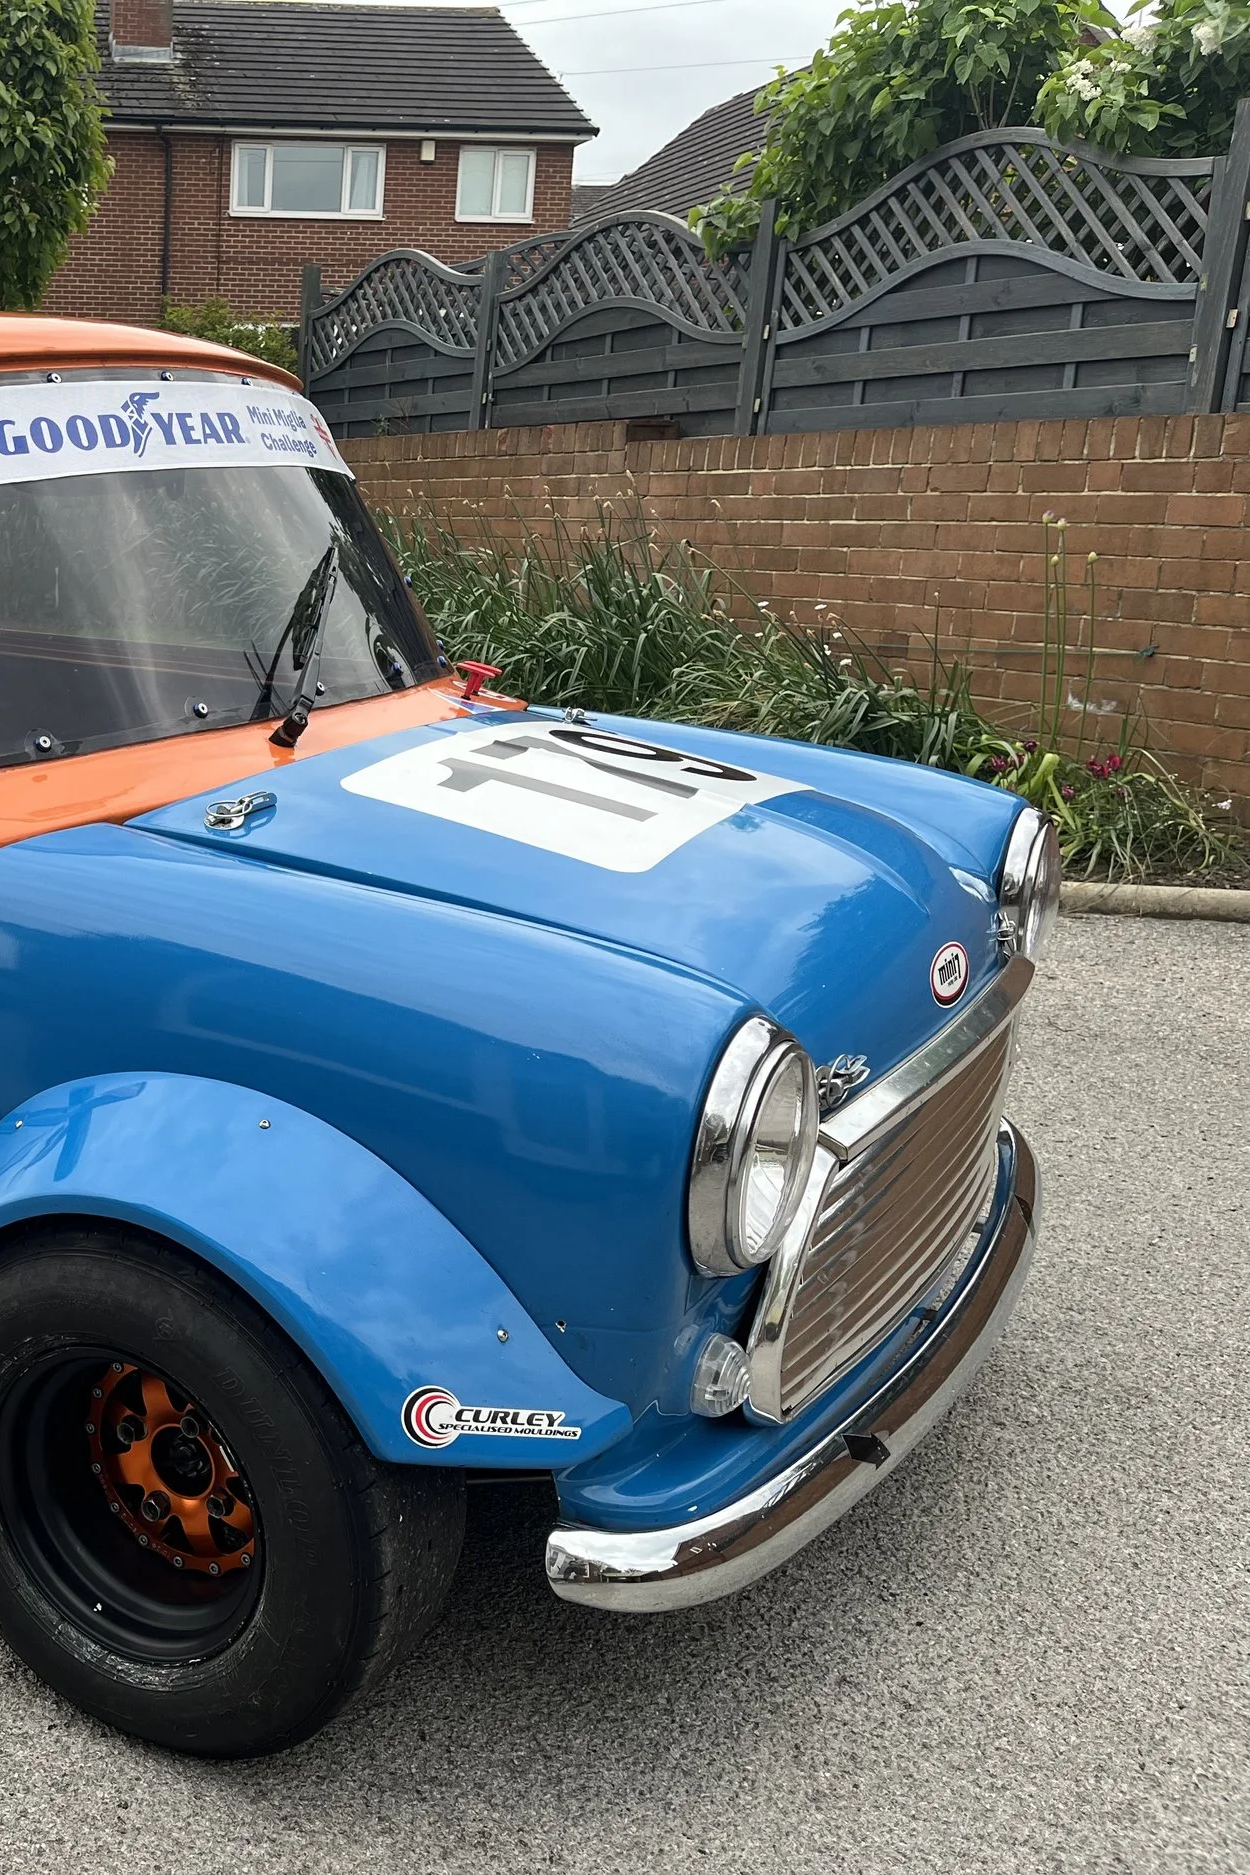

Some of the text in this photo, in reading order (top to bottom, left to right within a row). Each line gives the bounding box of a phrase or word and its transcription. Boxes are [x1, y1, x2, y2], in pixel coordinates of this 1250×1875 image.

[246, 405, 306, 432] Mini Miglia
[261, 432, 317, 458] Challenge
[937, 953, 961, 985] mini7
[438, 1423, 578, 1438] SPECIALISED MOULDINGS
[455, 1408, 563, 1427] CURLEY
